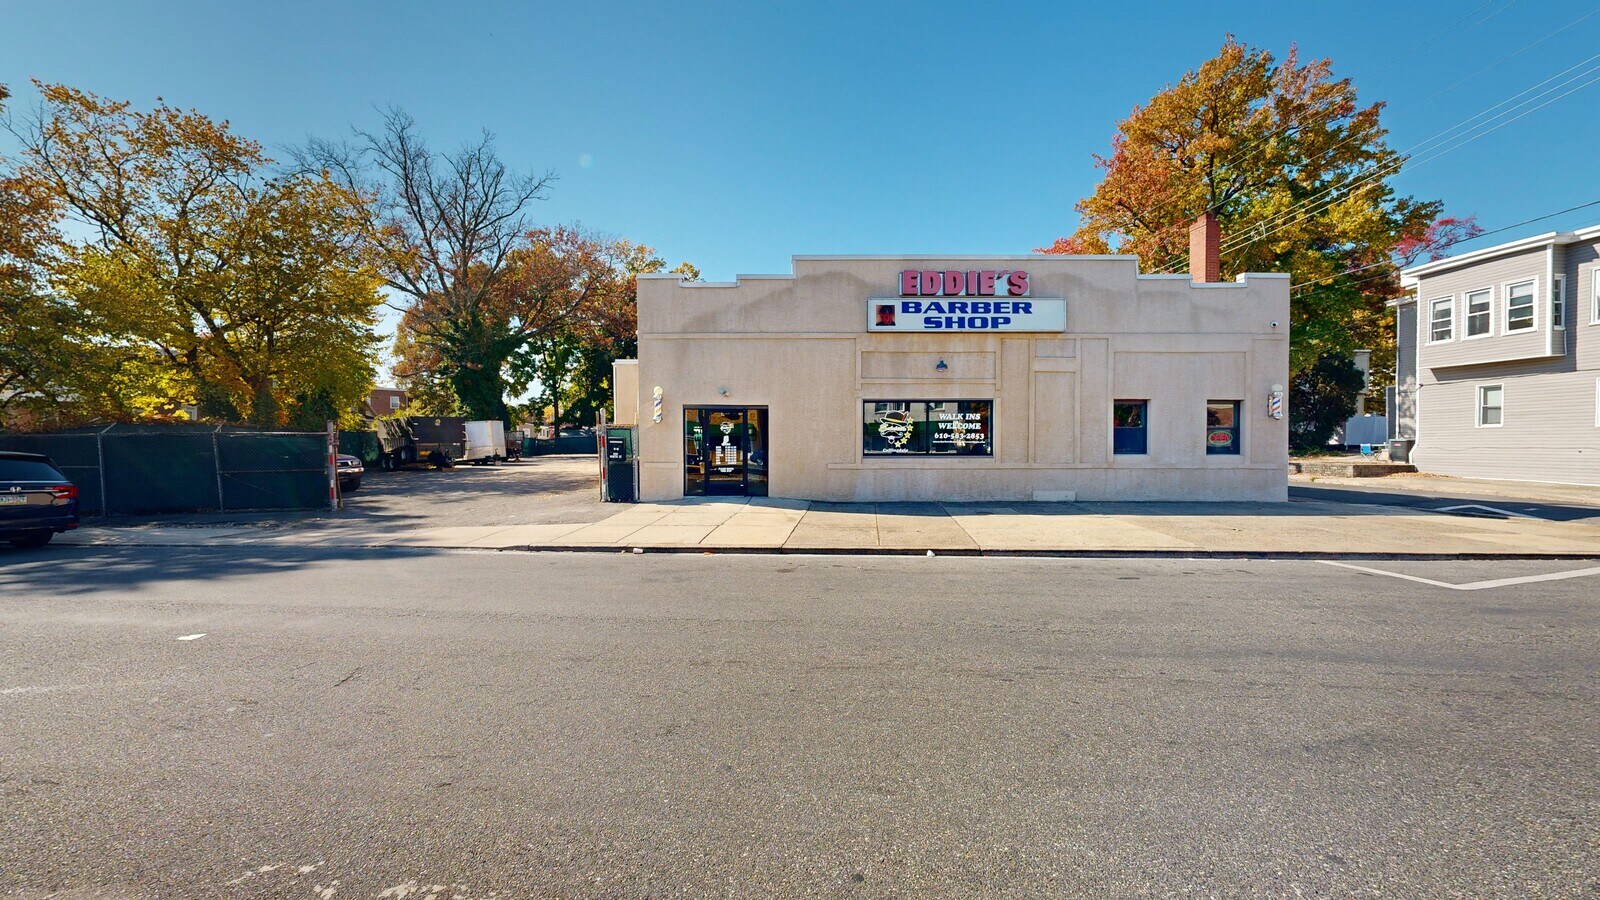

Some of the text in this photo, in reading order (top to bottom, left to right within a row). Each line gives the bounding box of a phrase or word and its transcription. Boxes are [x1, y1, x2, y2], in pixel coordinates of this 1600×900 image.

[900, 269, 1030, 296] EDDIE'S
[901, 301, 1033, 315] BARBER
[923, 316, 1012, 329] SHOP
[938, 422, 982, 430] WELCOME
[934, 432, 985, 440] 610-583-2853
[1210, 433, 1230, 443] OPEN
